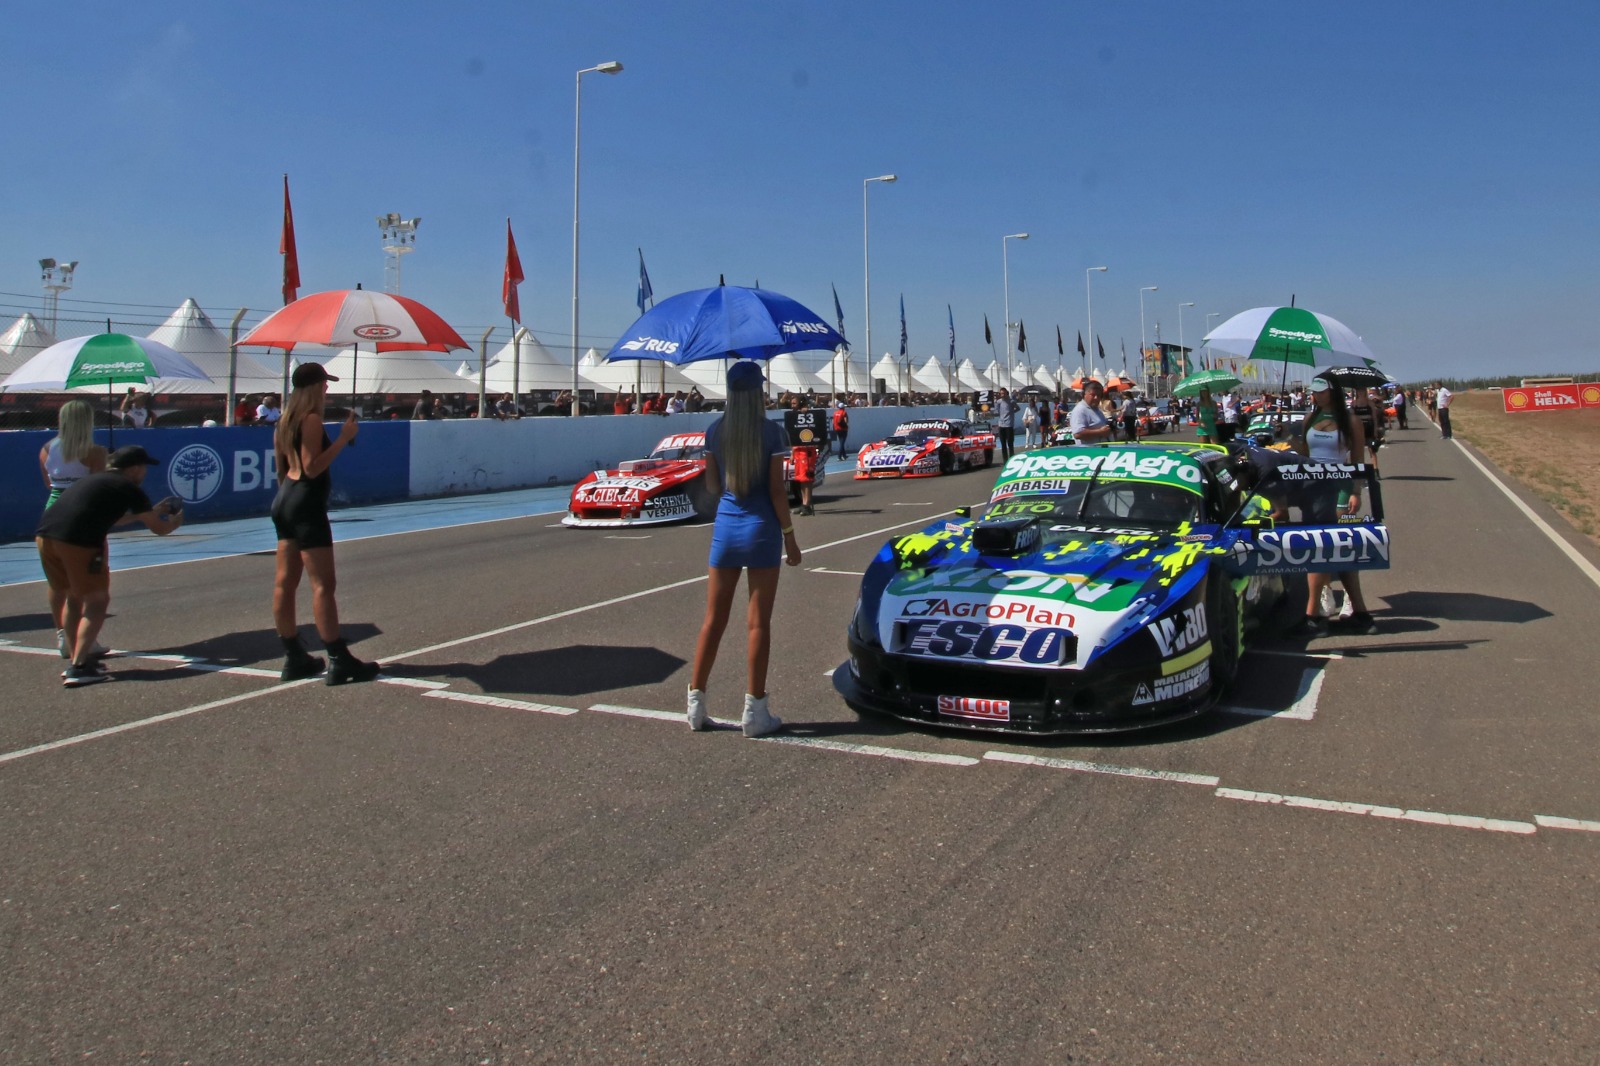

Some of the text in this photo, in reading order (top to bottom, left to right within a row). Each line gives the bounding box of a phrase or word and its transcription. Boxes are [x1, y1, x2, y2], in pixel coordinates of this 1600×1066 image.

[797, 322, 829, 334] RUS
[1269, 327, 1322, 340] SpeedAgro
[645, 338, 680, 354] RUS
[81, 361, 145, 371] SpeedAgro
[978, 390, 989, 402] 2
[1535, 393, 1577, 407] HELIX
[797, 413, 815, 425] 53
[657, 434, 706, 450] AKU
[869, 454, 906, 466] ESCO
[1001, 451, 1201, 484] SpeedAgro
[1311, 472, 1324, 480] TU
[653, 493, 692, 509] SCIENZA
[647, 505, 690, 518] VESPRINI
[990, 503, 1055, 517] LITO
[1049, 525, 1154, 535] CALICO
[928, 598, 1076, 628] AgroPlan
[905, 619, 1075, 665] ESCO
[939, 695, 1008, 715] SILOC
